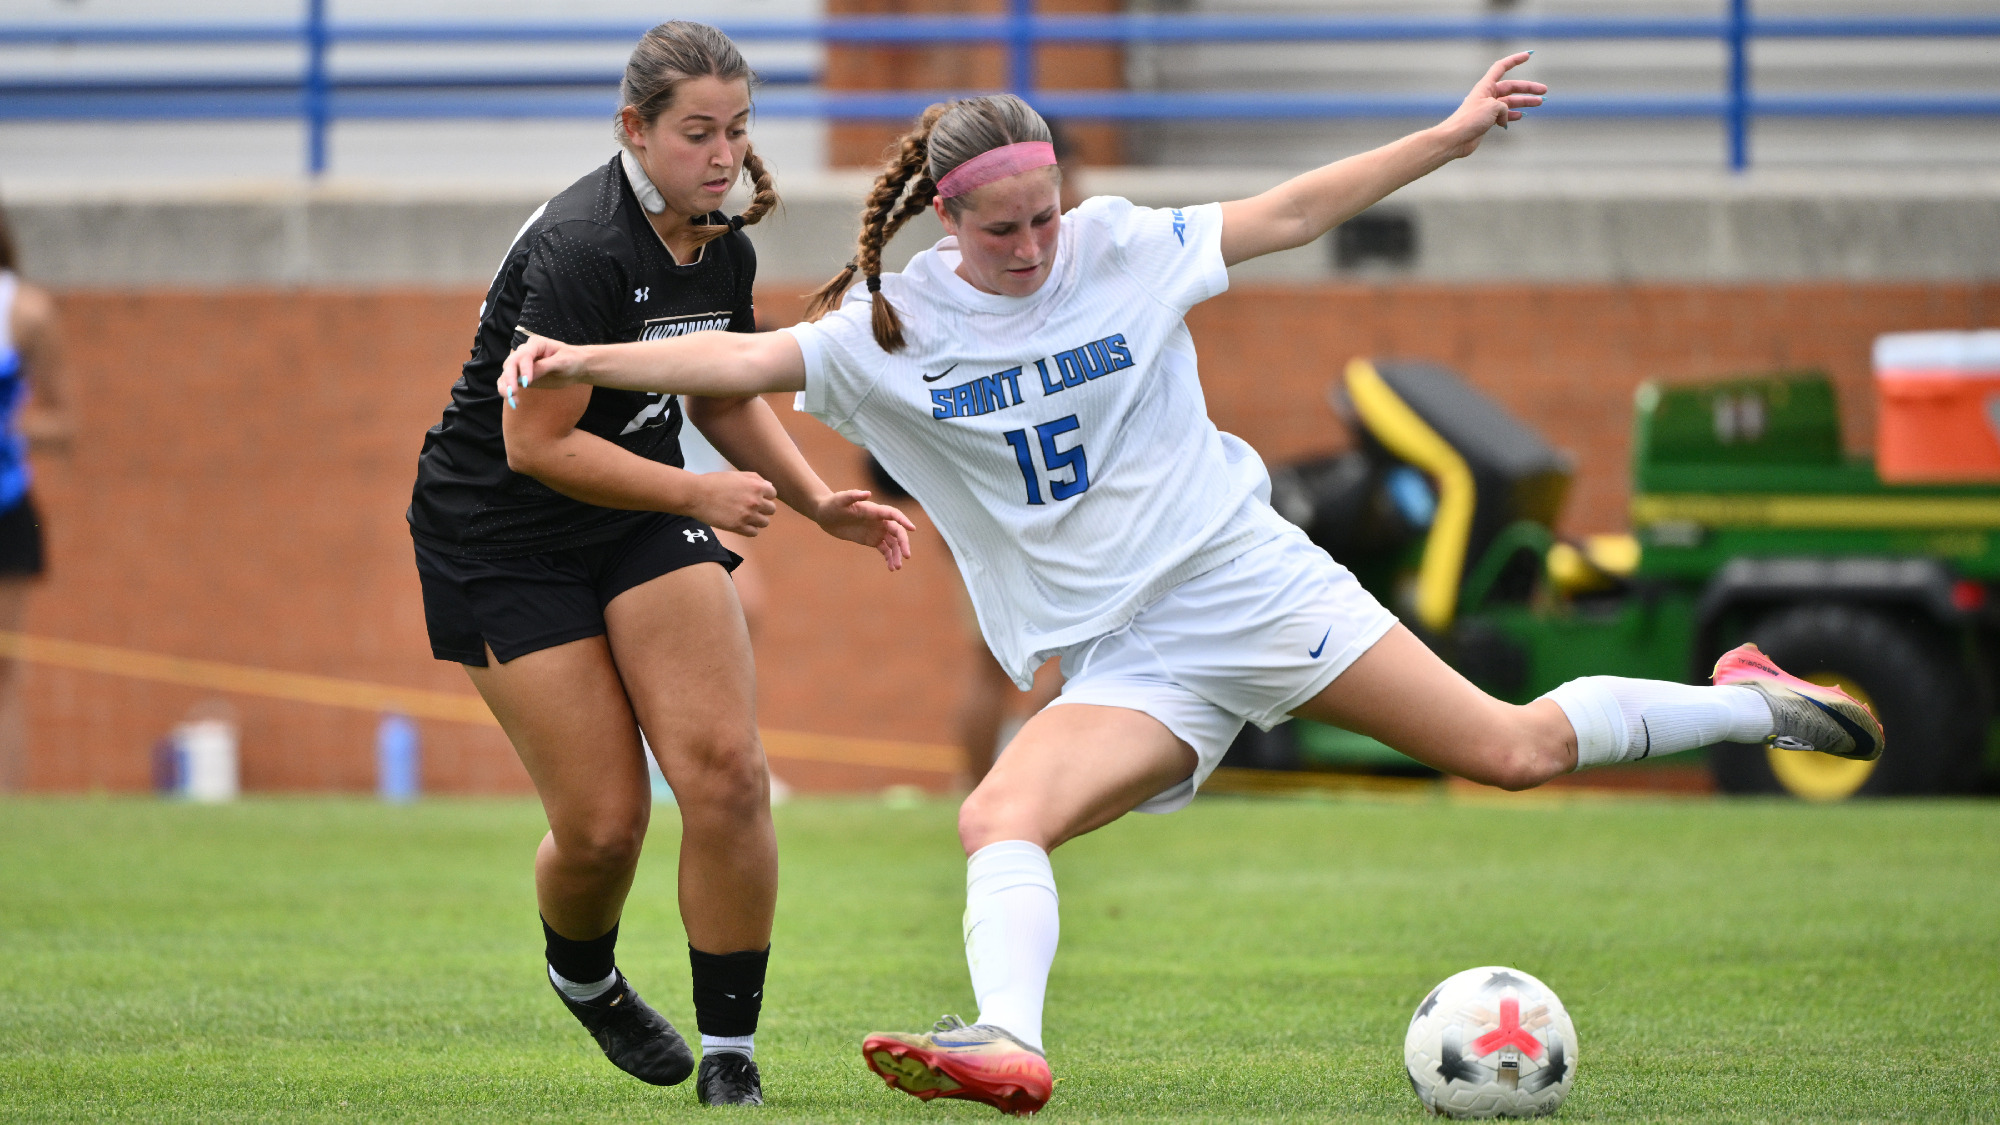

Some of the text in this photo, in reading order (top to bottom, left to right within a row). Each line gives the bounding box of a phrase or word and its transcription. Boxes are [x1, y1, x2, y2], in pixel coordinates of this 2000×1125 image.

[928, 333, 1135, 420] SAINT LOUIS
[1003, 413, 1090, 505] 15
